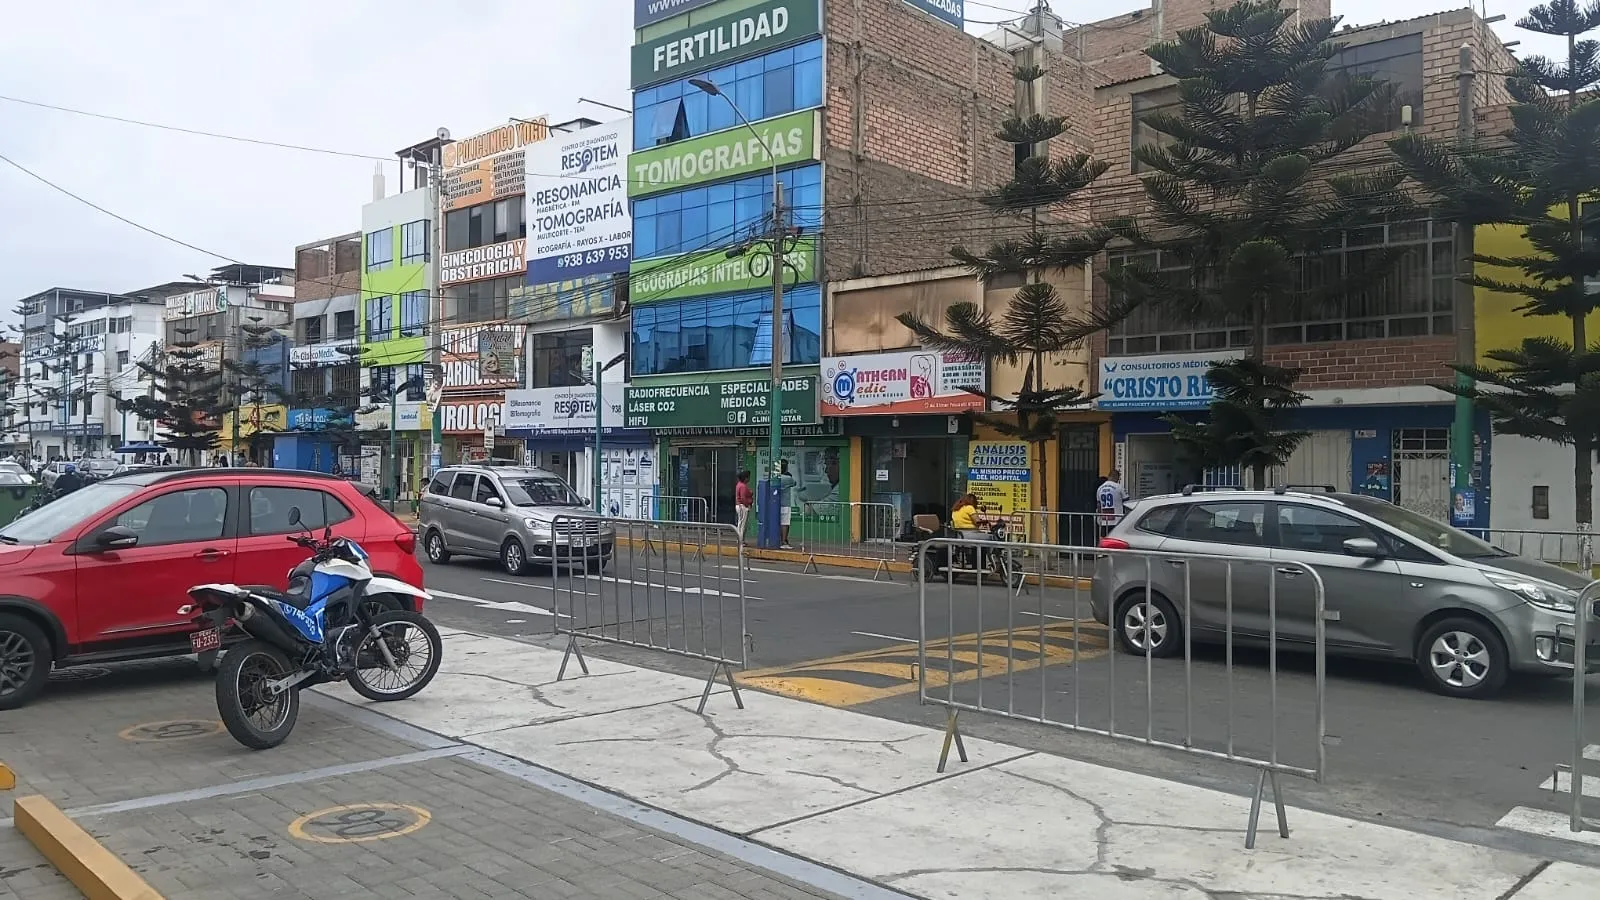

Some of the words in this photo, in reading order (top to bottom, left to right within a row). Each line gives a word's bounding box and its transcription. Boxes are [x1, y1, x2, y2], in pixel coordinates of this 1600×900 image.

[653, 6, 789, 72] FERTILIDAD
[561, 142, 619, 171] RESOTEM
[635, 126, 803, 188] TOMOGRAFÍAS
[536, 174, 622, 206] RESONANCIA
[536, 197, 624, 232] TOMOGRAFÍA
[441, 243, 514, 268] GINECOLOGIA
[516, 240, 525, 255] Y
[537, 240, 572, 254] ECOGRAFÍA
[576, 237, 598, 248] RAYOS
[564, 253, 583, 268] 938
[585, 249, 605, 264] 639
[608, 245, 629, 261] 953
[441, 256, 522, 283] OBSTETRICIA
[635, 263, 709, 294] ECOGRAFÍAS
[1120, 361, 1181, 371] CONSULTORIOS
[1182, 359, 1212, 369] MÉDIC
[628, 385, 711, 399] RADIOFRECUENCIA
[720, 379, 810, 395] ESPECIALADES
[1186, 374, 1214, 397] RE
[611, 404, 622, 414] 938
[628, 399, 656, 413] LÁSER
[657, 401, 676, 412] CO2
[720, 395, 767, 409] MÉDICAS
[628, 415, 649, 427] HIFU
[739, 424, 824, 437] DENSIMETRÍA
[973, 443, 1027, 455] ANÁLISIS
[1101, 493, 1114, 508] 99
